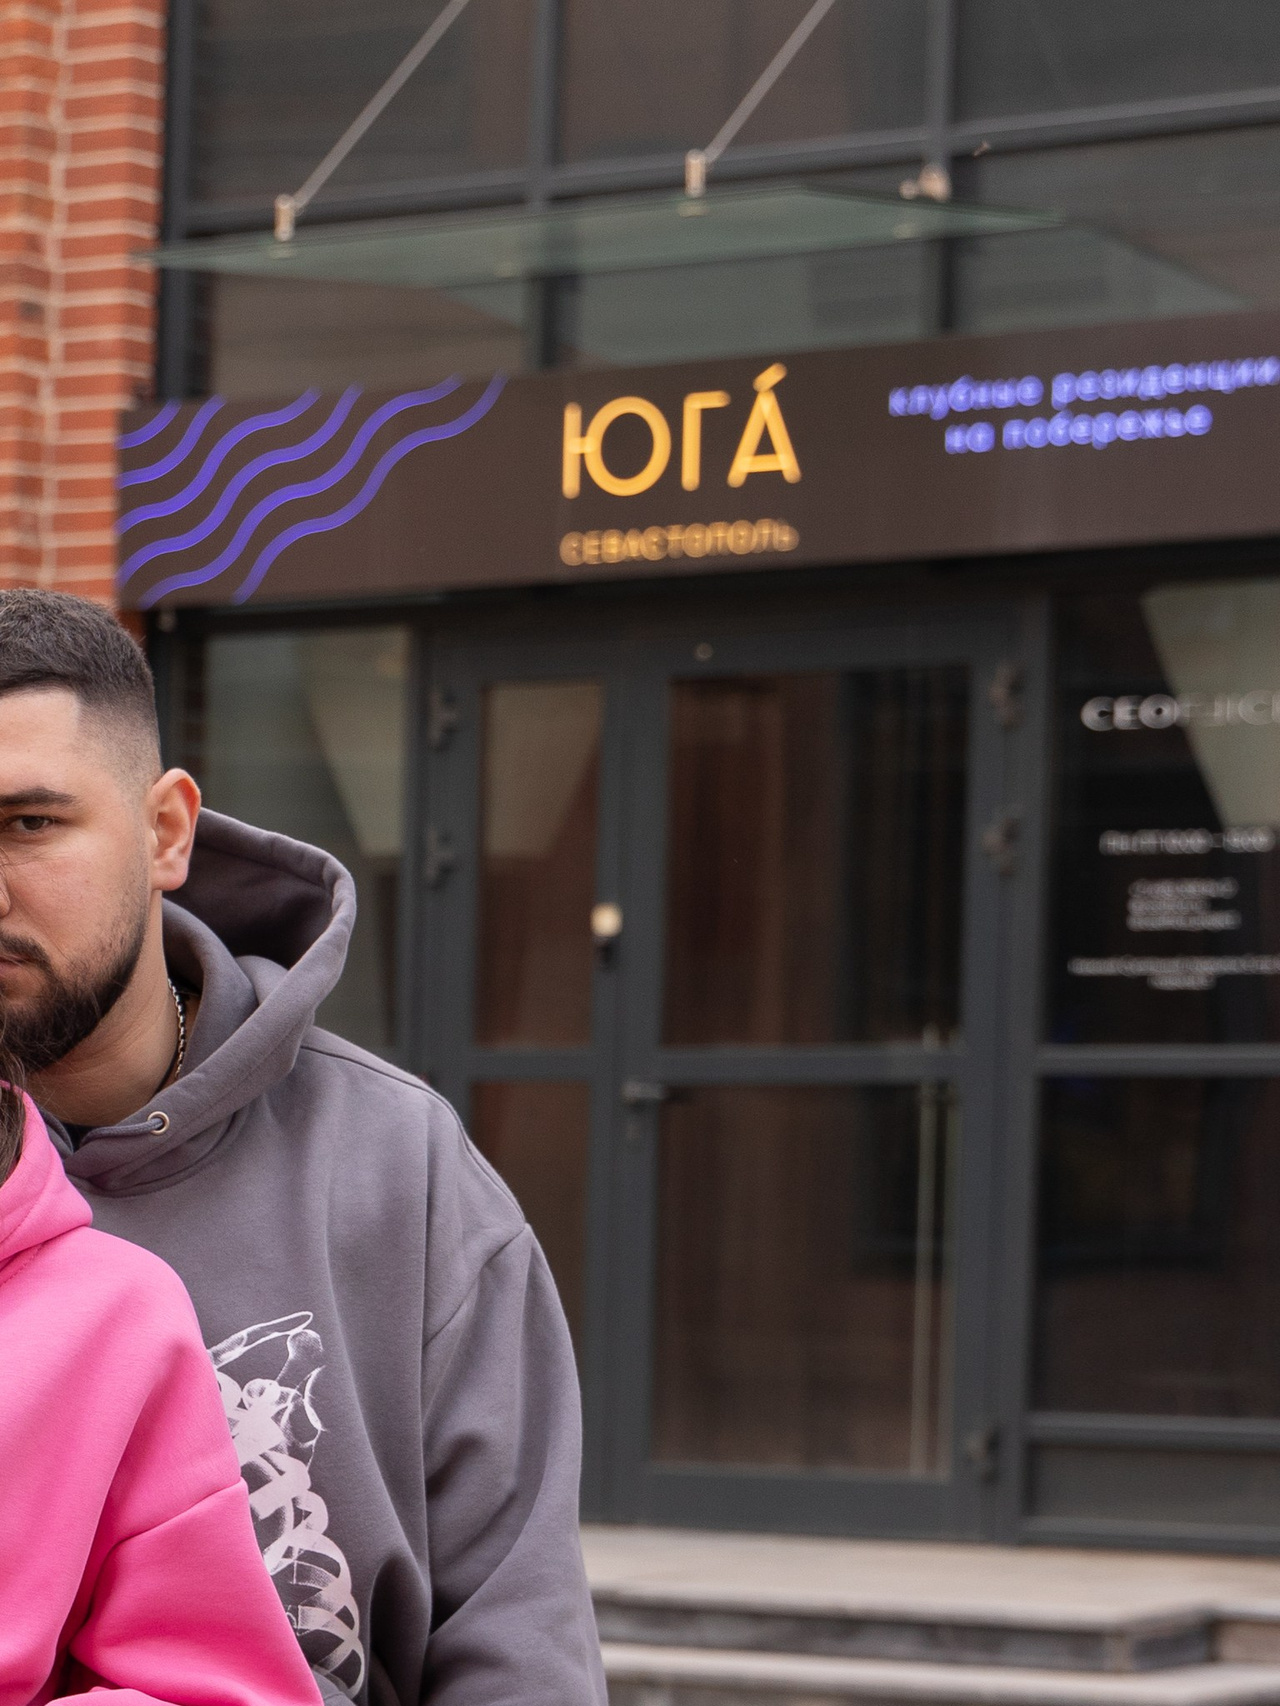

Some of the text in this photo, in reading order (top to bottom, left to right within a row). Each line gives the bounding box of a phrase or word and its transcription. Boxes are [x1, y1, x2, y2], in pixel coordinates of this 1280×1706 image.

[889, 374, 1044, 421] клубные
[945, 403, 1213, 454] на побережье
[560, 518, 800, 566] СЕВАСТОПОЛЬ
